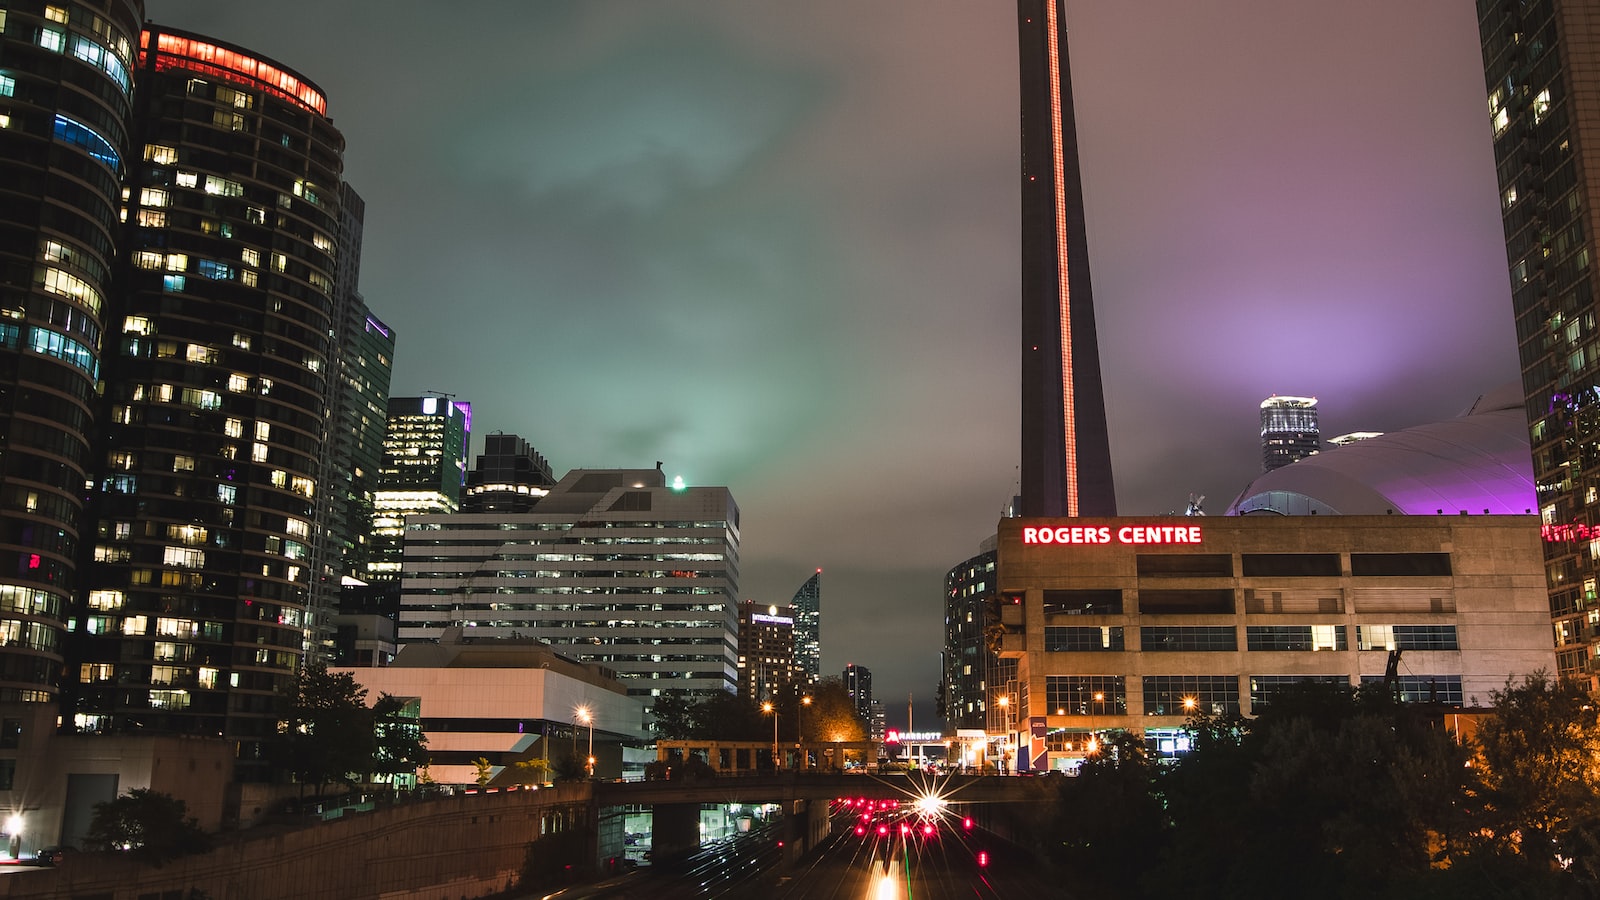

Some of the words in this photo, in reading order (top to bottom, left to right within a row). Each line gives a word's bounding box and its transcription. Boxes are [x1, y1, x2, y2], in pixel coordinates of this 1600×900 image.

[1024, 527, 1110, 543] ROGERS
[1118, 527, 1202, 543] CENTRE
[898, 732, 942, 740] MARRIOTT
